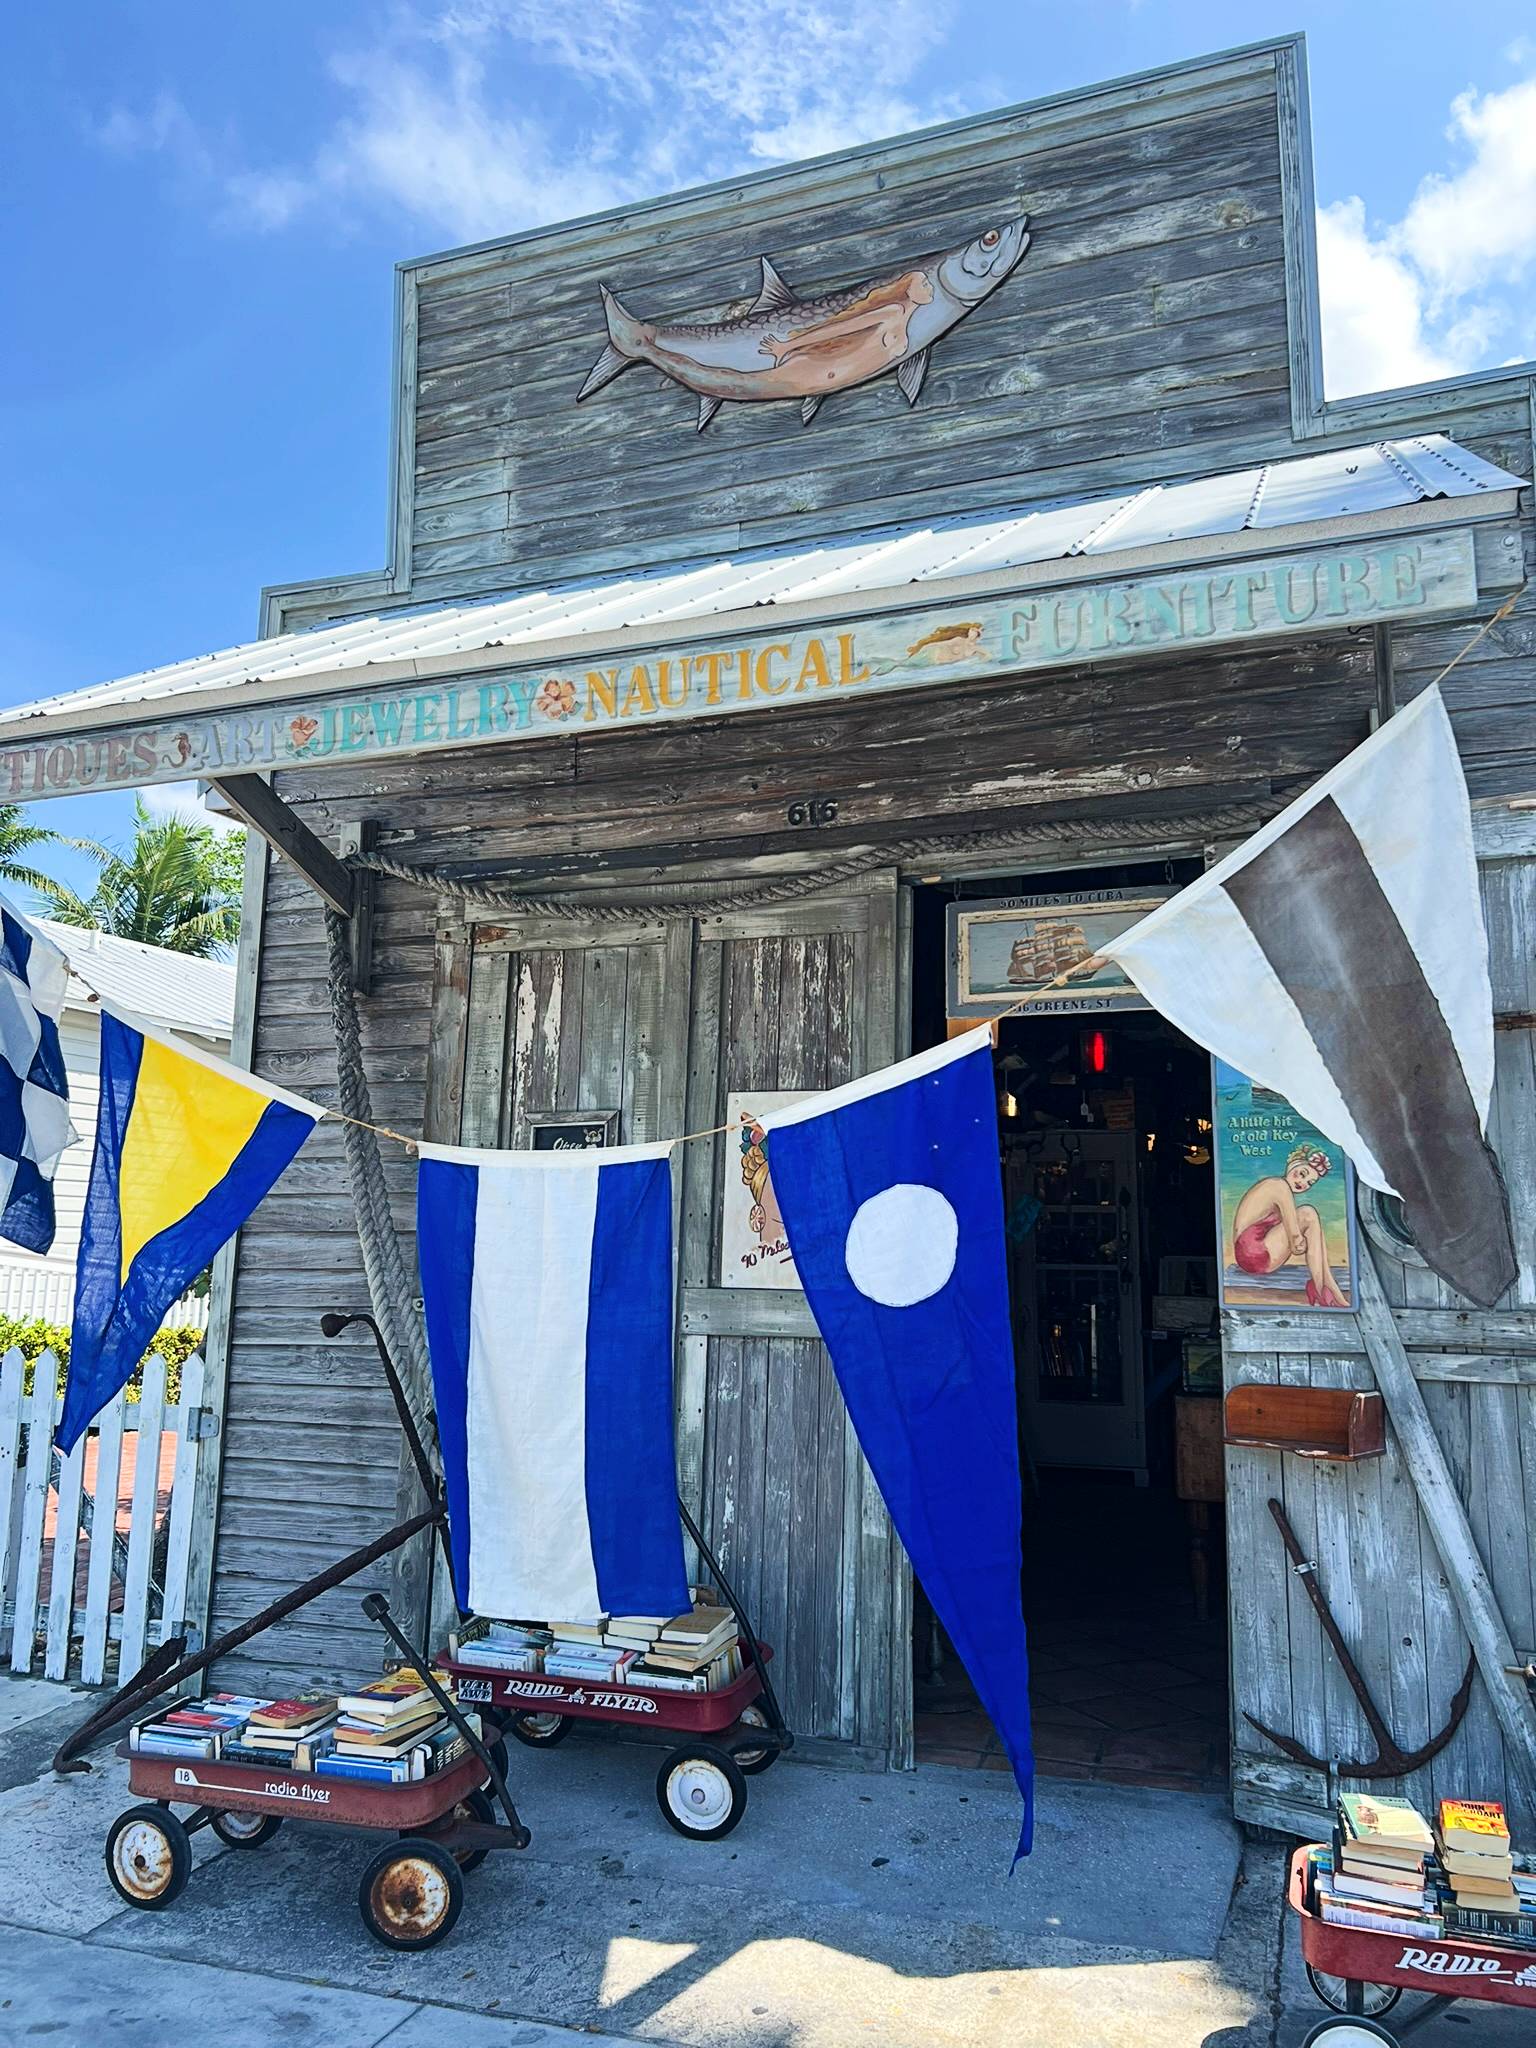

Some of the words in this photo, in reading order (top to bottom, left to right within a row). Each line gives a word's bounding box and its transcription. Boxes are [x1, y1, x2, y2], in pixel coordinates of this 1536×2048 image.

[0, 731, 158, 794] TIQUES
[200, 715, 285, 770] ART
[314, 676, 543, 757] JEWELRY
[583, 633, 872, 722] NAUTICAL
[999, 547, 1427, 662] FURNITURE
[788, 799, 838, 826] 616
[1000, 899, 1016, 909] 90
[1020, 896, 1060, 907] MILES
[1066, 894, 1083, 904] TO
[1088, 891, 1123, 902] CUBA
[1096, 999, 1113, 1009] ST
[1228, 1117, 1239, 1128] A
[1240, 1116, 1270, 1128] little
[1272, 1115, 1293, 1128] bit
[1231, 1131, 1246, 1143] of
[1246, 1130, 1268, 1142] old
[1272, 1130, 1298, 1144] Key
[1240, 1145, 1272, 1157] West
[741, 1253, 758, 1268] 90
[504, 1679, 565, 1698] RADIO
[590, 1693, 659, 1714] FLYER
[179, 1770, 191, 1783] 18
[265, 1781, 298, 1797] radio
[301, 1783, 331, 1801] flyer
[1395, 1947, 1502, 1973] RADIO
